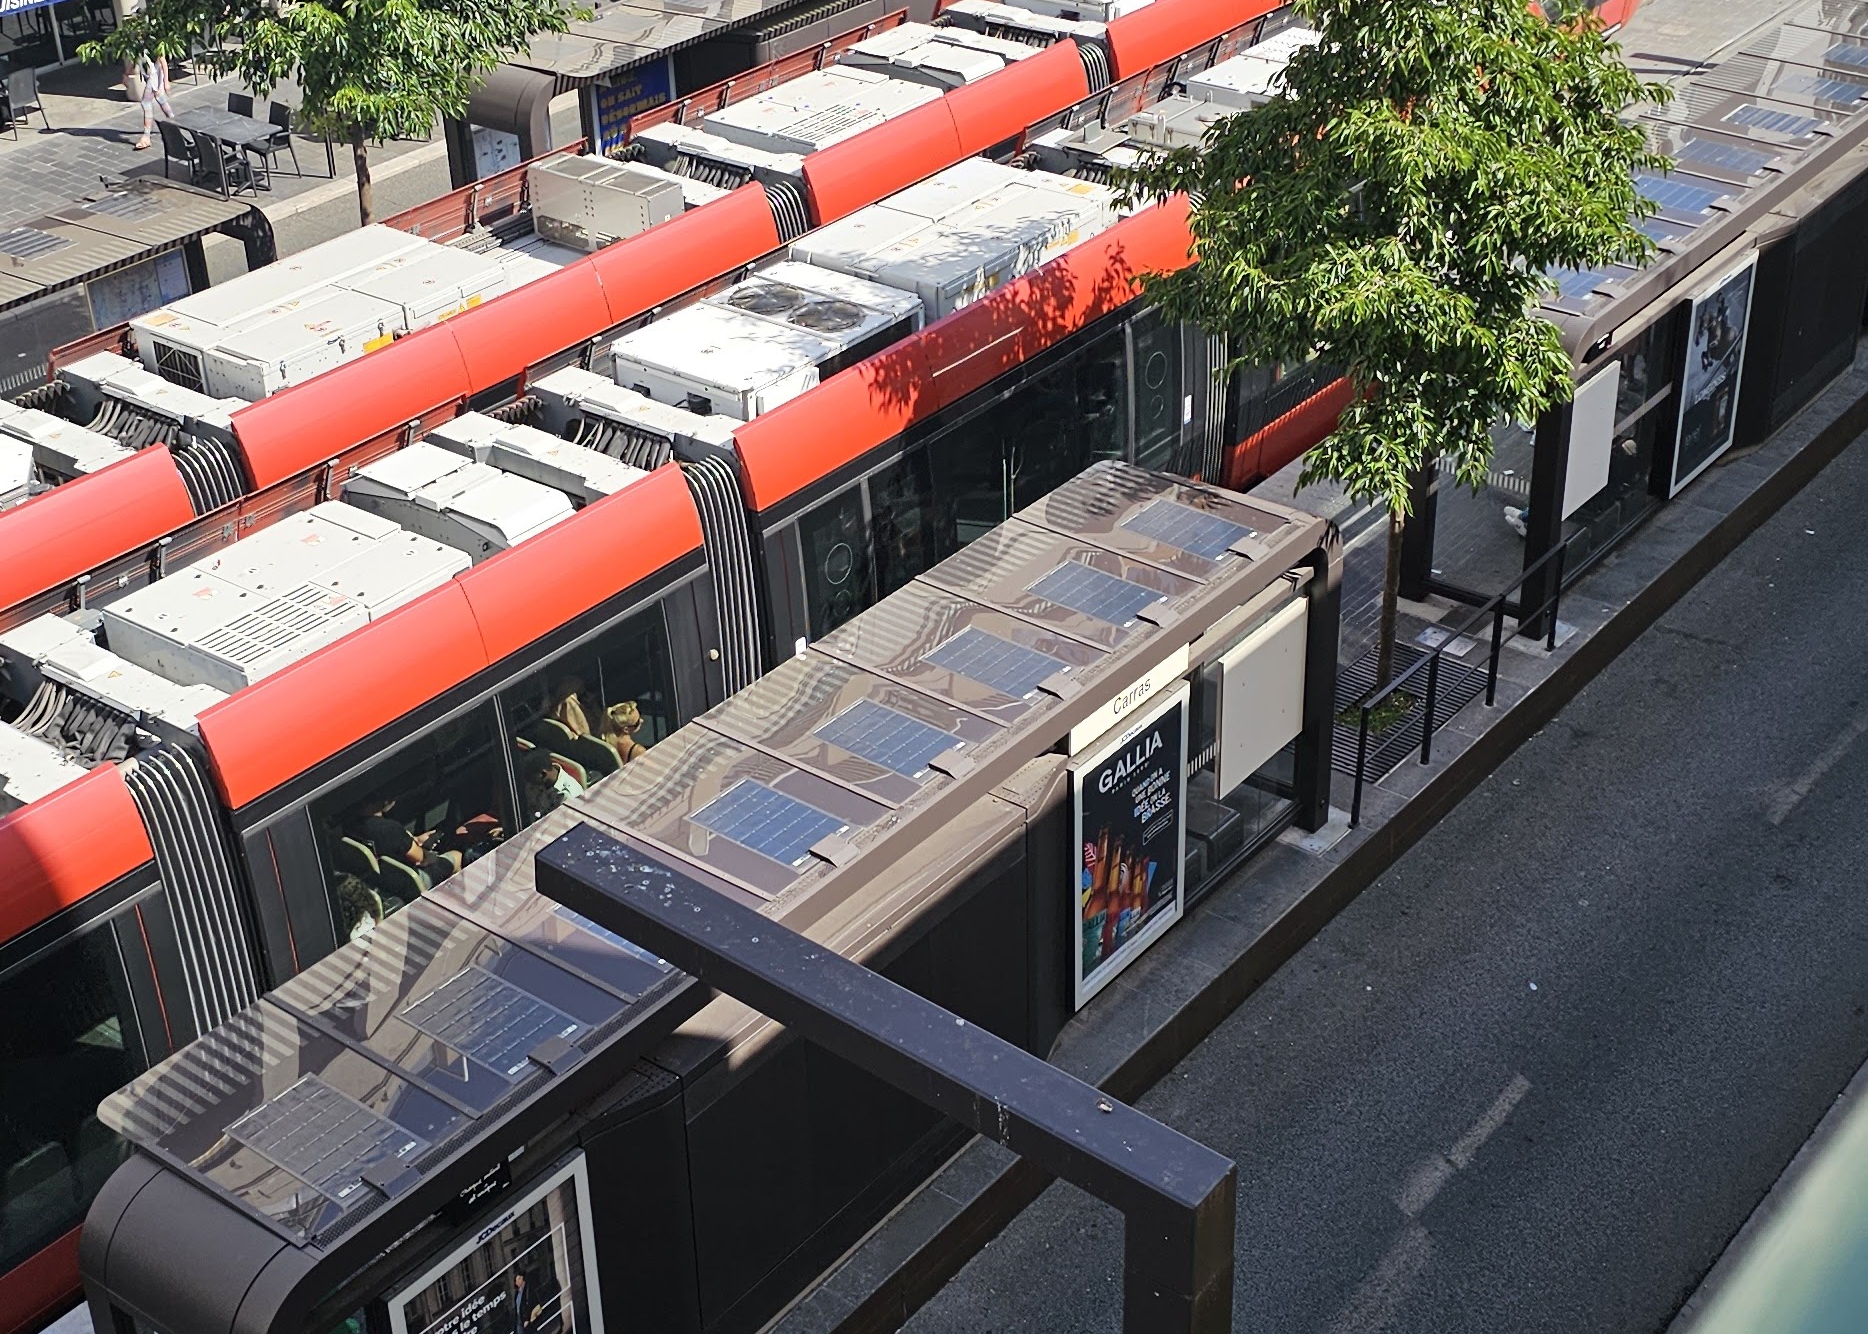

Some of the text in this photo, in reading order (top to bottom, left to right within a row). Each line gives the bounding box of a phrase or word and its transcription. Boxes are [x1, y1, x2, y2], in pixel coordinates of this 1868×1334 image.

[1113, 678, 1151, 715] Carras
[1098, 730, 1163, 794] GALLIA
[476, 1211, 515, 1245] JCDecaux
[460, 1295, 486, 1319] idée
[460, 1319, 471, 1332] le
[471, 1290, 507, 1322] temps
